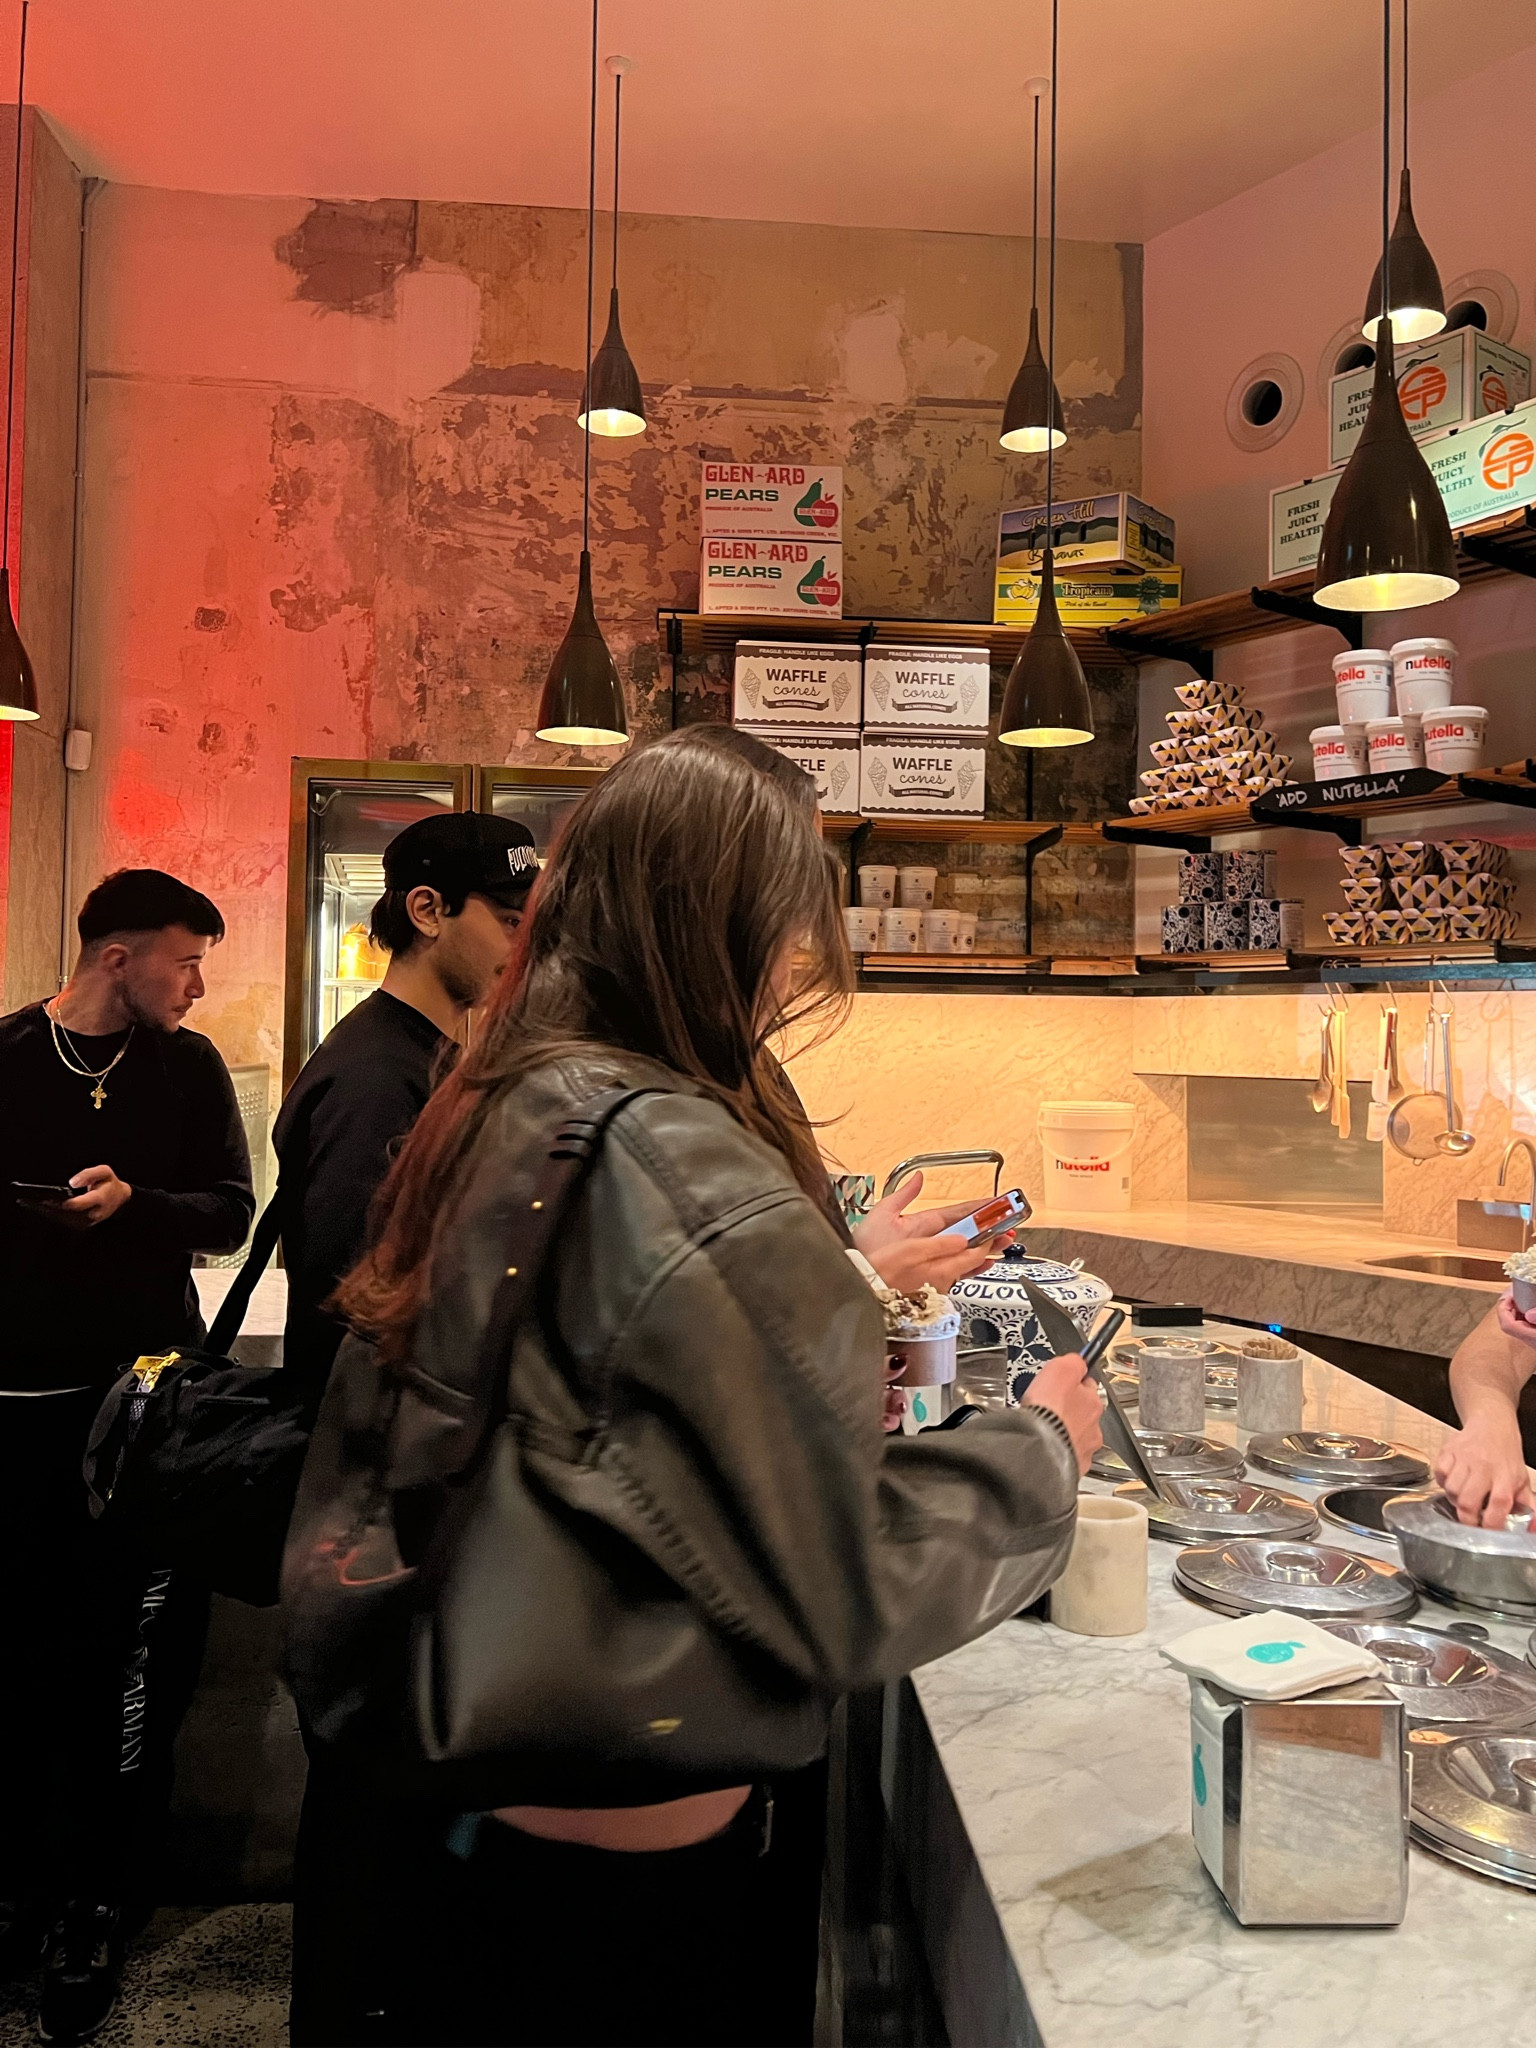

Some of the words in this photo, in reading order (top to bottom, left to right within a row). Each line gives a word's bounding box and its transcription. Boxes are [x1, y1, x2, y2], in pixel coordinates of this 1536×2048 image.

[1347, 388, 1374, 404] FRES
[1348, 403, 1371, 416] JUIC
[1339, 416, 1366, 432] HEAL
[1409, 421, 1432, 433] TRALIA
[1431, 451, 1467, 471] FRESH
[1440, 475, 1475, 495] ALTHY
[706, 489, 779, 502] PEARS
[1482, 491, 1520, 507] AUSTRALIA
[1068, 501, 1094, 519] Hill
[1288, 500, 1320, 517] FRESH
[1288, 513, 1319, 529] JUICY
[1027, 549, 1084, 565] Bnanas
[708, 565, 782, 579] PEARS
[1062, 583, 1113, 599] Tropicana
[1405, 656, 1451, 671] nutella
[766, 668, 827, 683] WAFFLE
[895, 671, 955, 686] WAFFLE
[1335, 667, 1365, 685] utella
[773, 686, 821, 697] cones
[902, 688, 950, 699] cones
[1425, 723, 1464, 741] utella
[1368, 733, 1405, 750] utella
[1313, 742, 1345, 758] utella
[892, 757, 952, 771] WAFFLE
[900, 774, 946, 785] cones
[119, 1683, 146, 1773] ARMANI
